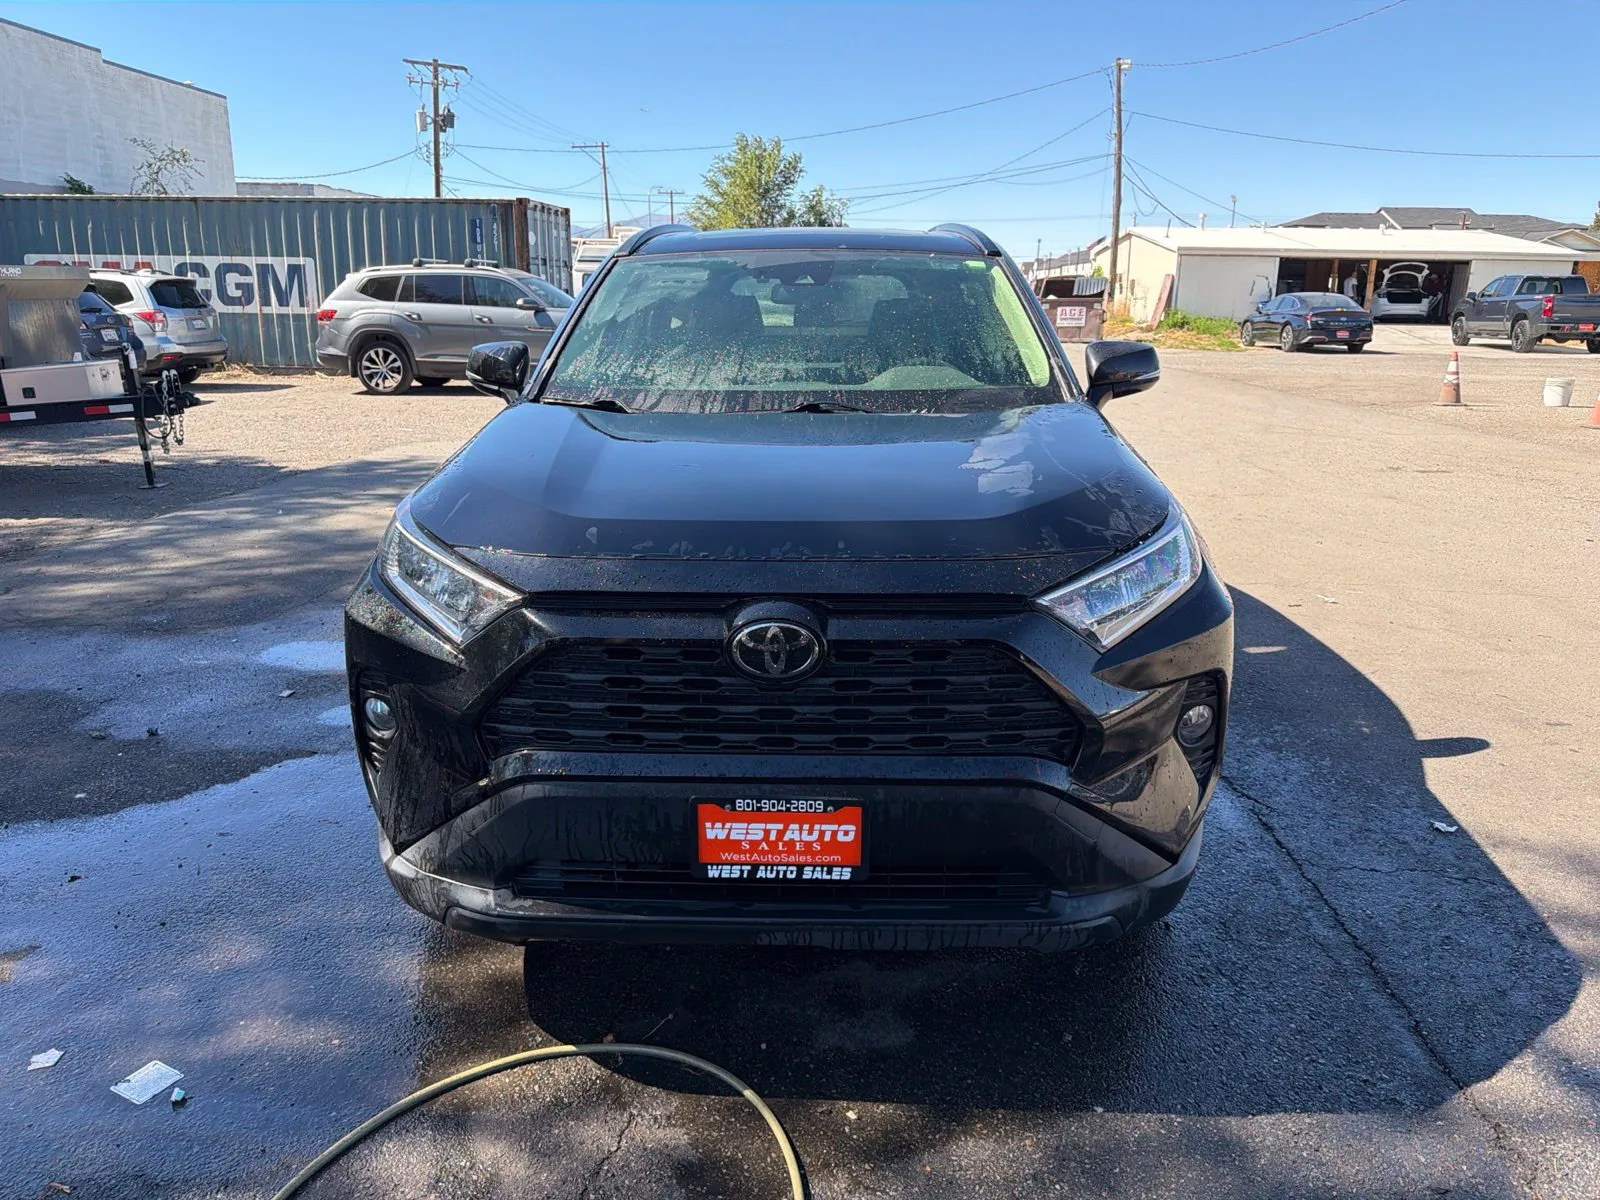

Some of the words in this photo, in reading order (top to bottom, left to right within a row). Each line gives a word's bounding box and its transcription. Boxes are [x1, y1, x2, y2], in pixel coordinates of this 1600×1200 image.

[735, 799, 824, 812] 801-904-2809
[741, 841, 822, 850] SALES
[720, 851, 842, 863] WestAutoSales.com
[707, 865, 751, 878] WEST
[756, 865, 797, 879] AUTO
[802, 867, 852, 880] SALES
